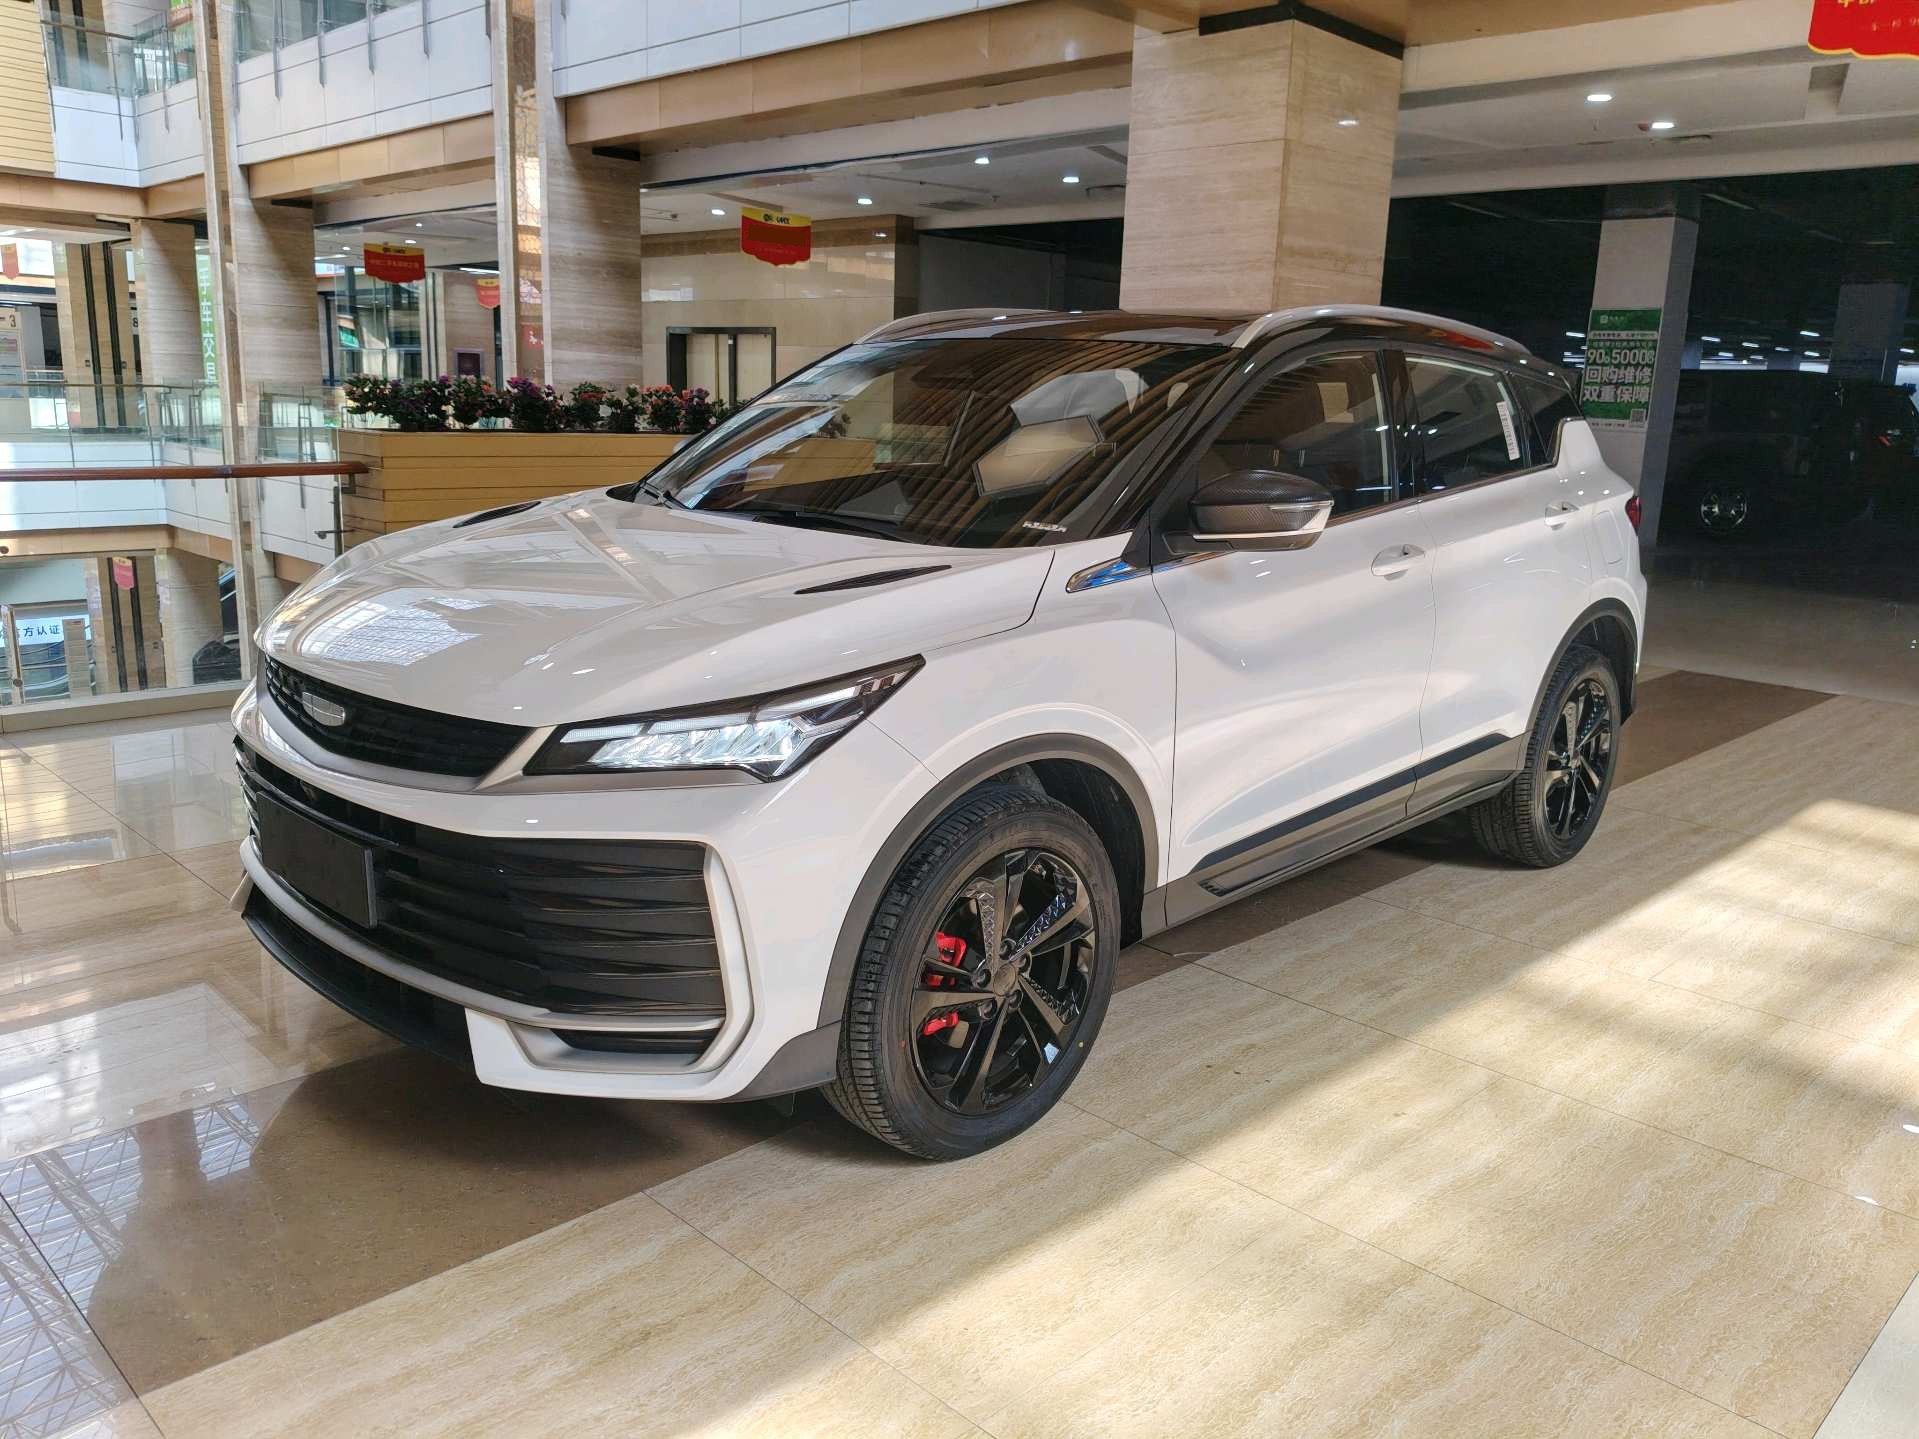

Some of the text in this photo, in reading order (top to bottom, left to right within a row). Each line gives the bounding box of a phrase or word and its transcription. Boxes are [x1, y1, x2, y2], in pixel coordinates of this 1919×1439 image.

[1586, 366, 1652, 384] 回购维修
[17, 625, 59, 637] 方认证
